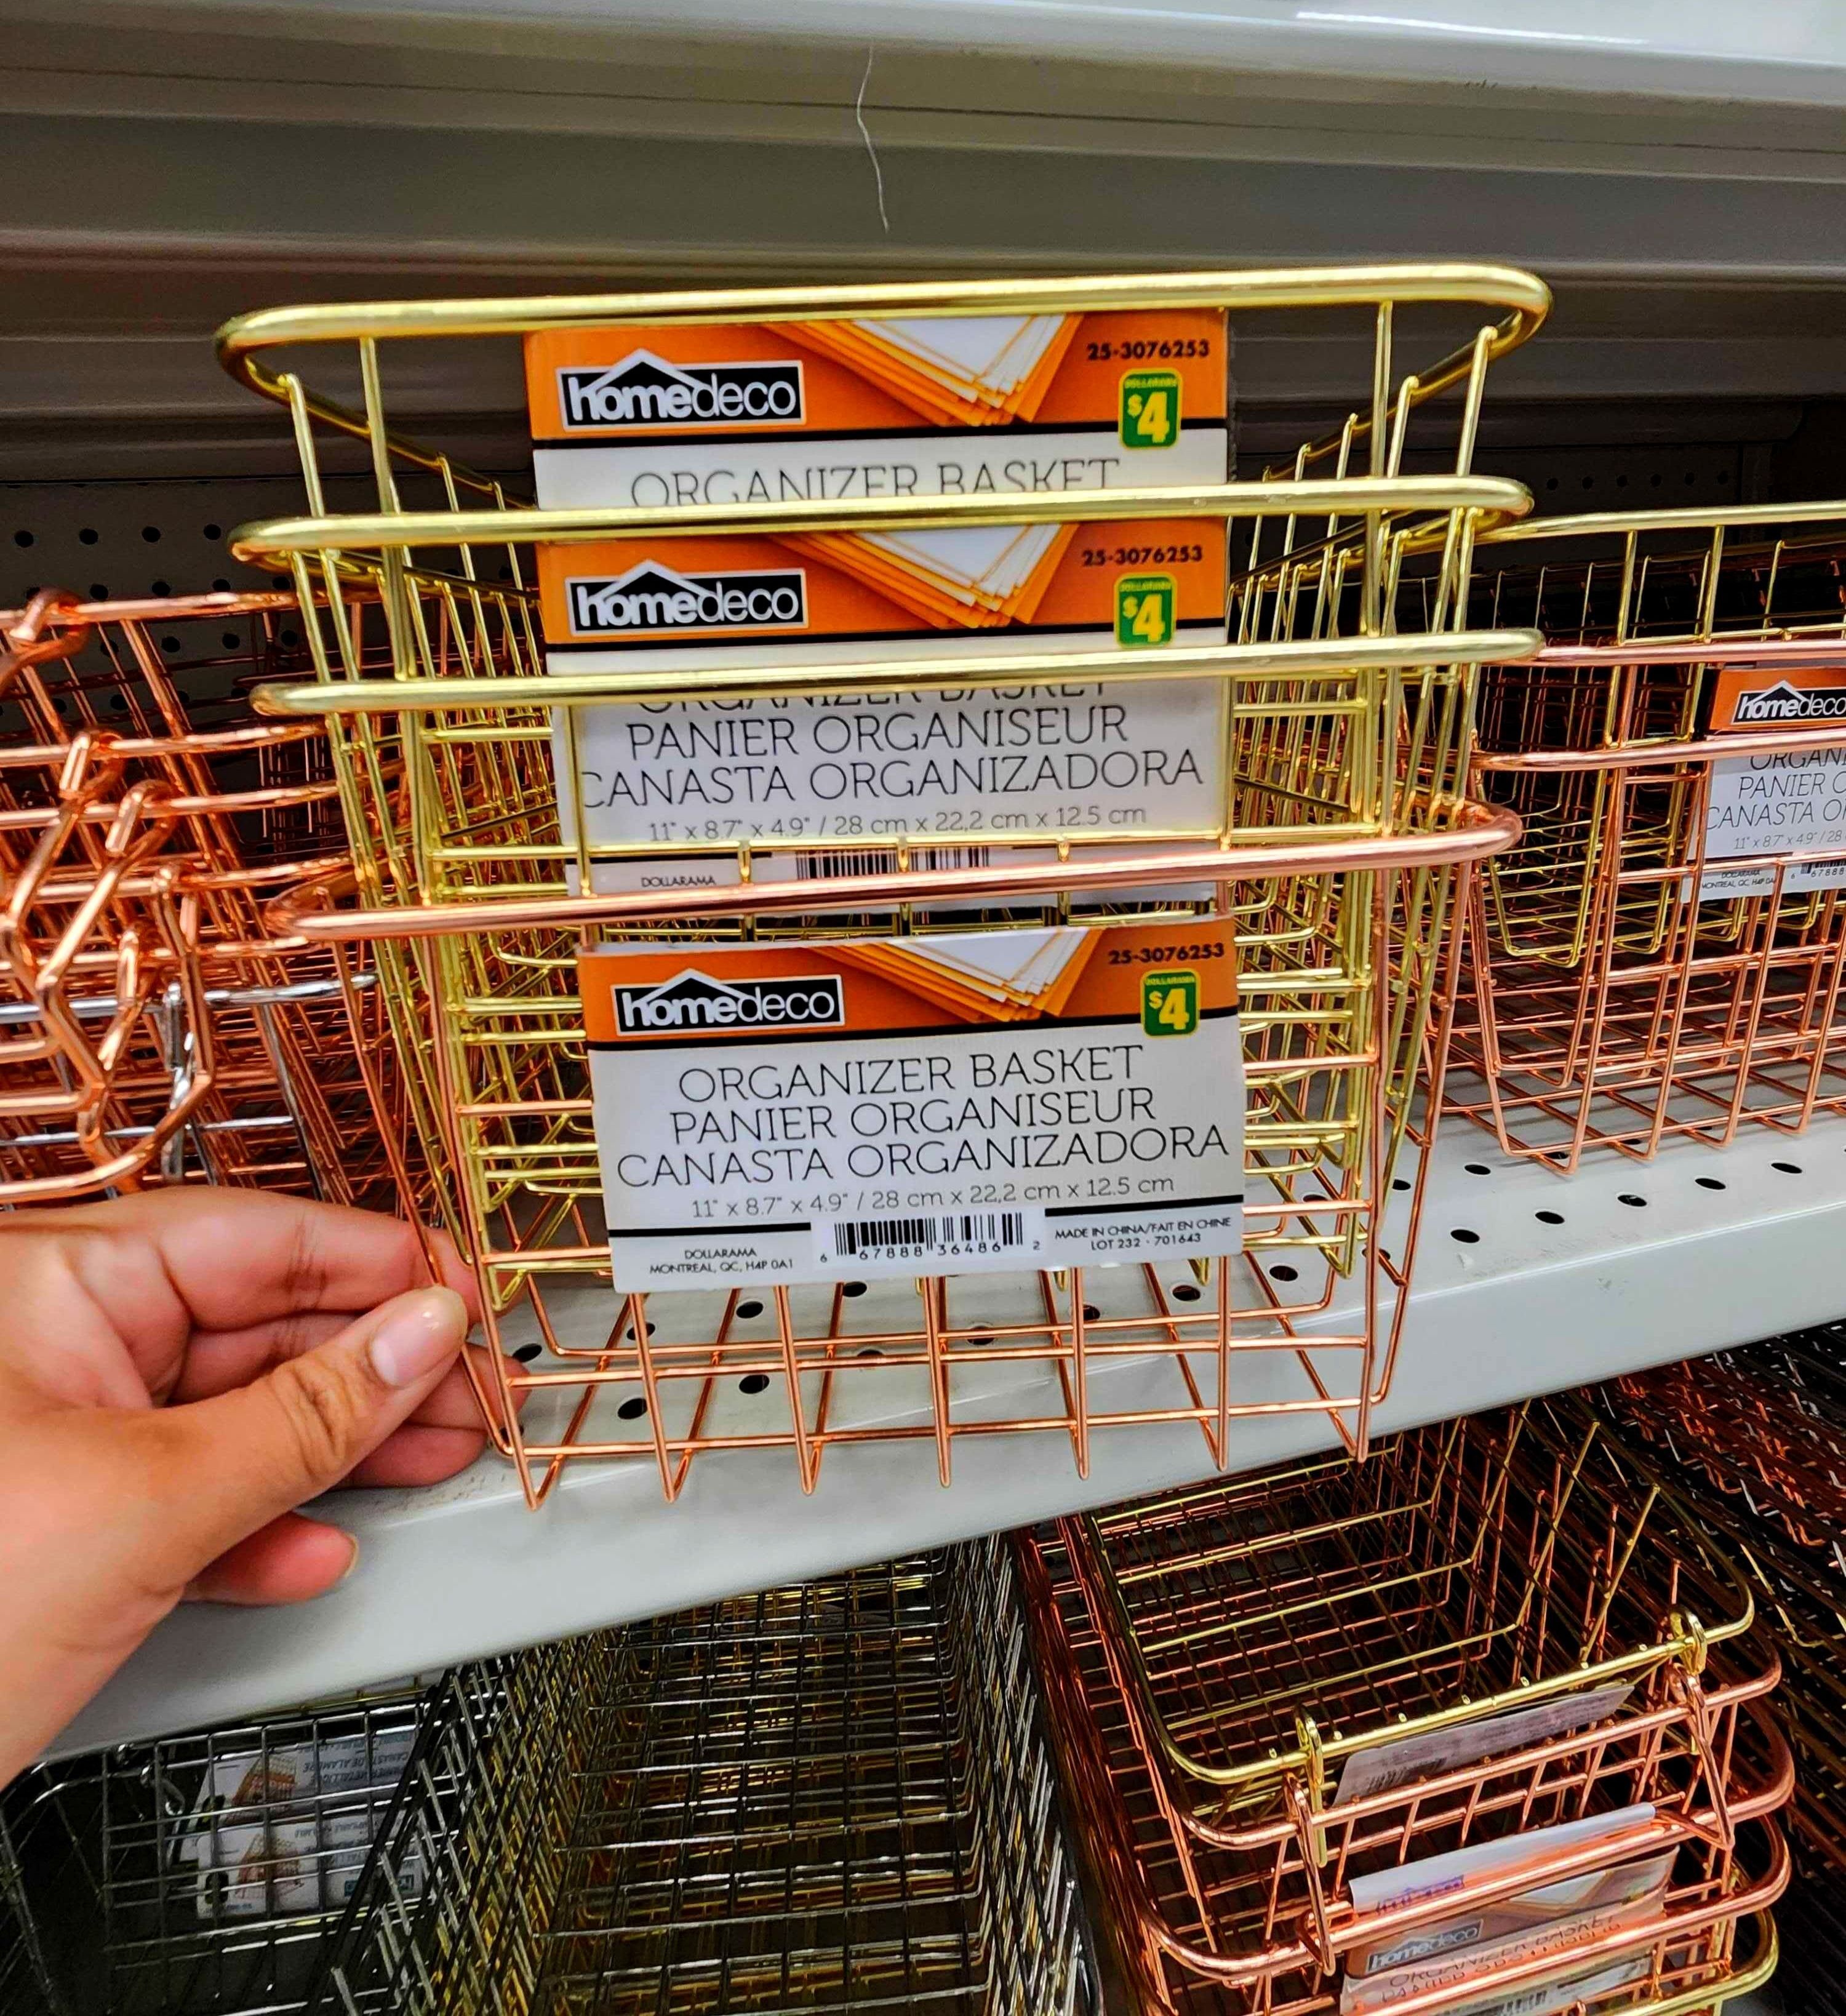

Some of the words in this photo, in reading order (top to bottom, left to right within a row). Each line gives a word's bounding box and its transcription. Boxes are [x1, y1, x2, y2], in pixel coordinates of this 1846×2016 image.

[1087, 338, 1210, 360] 25-3076253
[568, 372, 797, 421] homedeco
[1127, 391, 1170, 444] $4
[631, 463, 919, 507] ORGANIZER
[938, 458, 1120, 495] BASKET
[1082, 544, 1203, 566] 25-3076253
[576, 581, 799, 626] homedeco
[1122, 593, 1165, 642] $4
[1737, 693, 1846, 719] homedeco
[626, 716, 799, 761] PANIER
[813, 705, 1128, 754] ORGANISEUR
[581, 766, 796, 808] CANASTA
[810, 748, 1204, 800] ORGANIZADORA
[1738, 772, 1826, 799] PANIER
[685, 825, 698, 839] x
[751, 823, 764, 838] x
[834, 815, 863, 836] 28
[871, 818, 907, 833] cm
[916, 817, 928, 832] x
[991, 814, 1029, 830] cm
[1037, 812, 1048, 826] x
[1056, 806, 1100, 826] 12.5
[1108, 807, 1147, 825] cm
[1707, 801, 1814, 830] CANASTA
[1826, 830, 1842, 842] 28
[641, 876, 716, 887] DOLLARAMA
[1108, 942, 1225, 964] 25-3076253
[621, 986, 835, 1027] homedeco
[1148, 988, 1190, 1030] $4
[679, 1056, 956, 1103] ORGANIZER
[969, 1044, 1143, 1088] BASKET
[669, 1105, 837, 1145] PANIER
[850, 1087, 1157, 1137] ORGANISEUR
[617, 1148, 834, 1188] CANASTA
[848, 1124, 1229, 1178] ORGANIZADORA
[692, 1199, 717, 1218] 11"
[727, 1203, 739, 1217] x
[746, 1197, 782, 1216] 8.7"
[791, 1200, 802, 1213] x
[810, 1193, 848, 1212] 4.9"
[871, 1190, 899, 1210] 28
[907, 1192, 943, 1208] cm
[950, 1191, 963, 1204] x
[1023, 1185, 1061, 1201] cm
[1067, 1184, 1080, 1198] x
[1087, 1177, 1130, 1198] 12.5
[1138, 1178, 1175, 1193] cm
[1055, 1228, 1089, 1239] MADE
[1092, 1226, 1105, 1237] IN
[1108, 1222, 1174, 1235] CHINA/FAIT
[1178, 1220, 1193, 1230] EN
[1196, 1217, 1231, 1229] CHINE
[1091, 1239, 1114, 1250] LOT
[1117, 1238, 1141, 1249] 232
[1154, 1233, 1201, 1246] 701643
[684, 1247, 757, 1260] DOLLARAMA
[746, 1261, 768, 1271] H4P
[820, 1254, 828, 1263] 6
[859, 1246, 923, 1260] 67888
[937, 1241, 1001, 1256] 36486
[1033, 1241, 1041, 1250] 2
